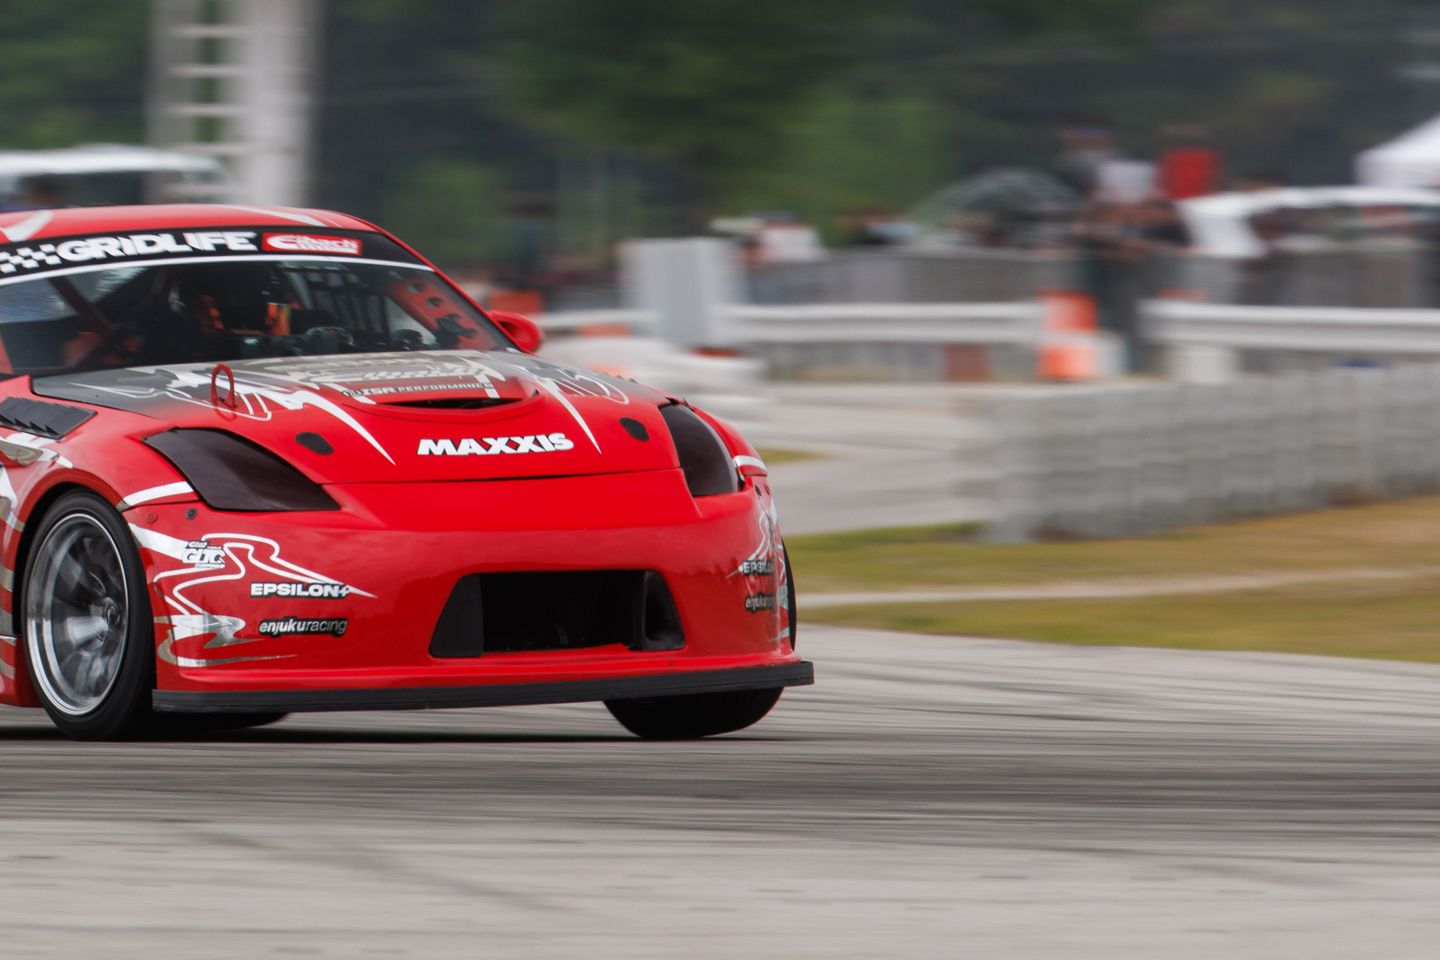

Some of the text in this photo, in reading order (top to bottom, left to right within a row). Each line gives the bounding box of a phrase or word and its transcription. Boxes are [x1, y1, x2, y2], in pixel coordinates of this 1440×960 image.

[56, 231, 258, 261] GRIDLIFE
[417, 433, 574, 455] MAXXIS
[259, 618, 348, 634] enjukuracing
